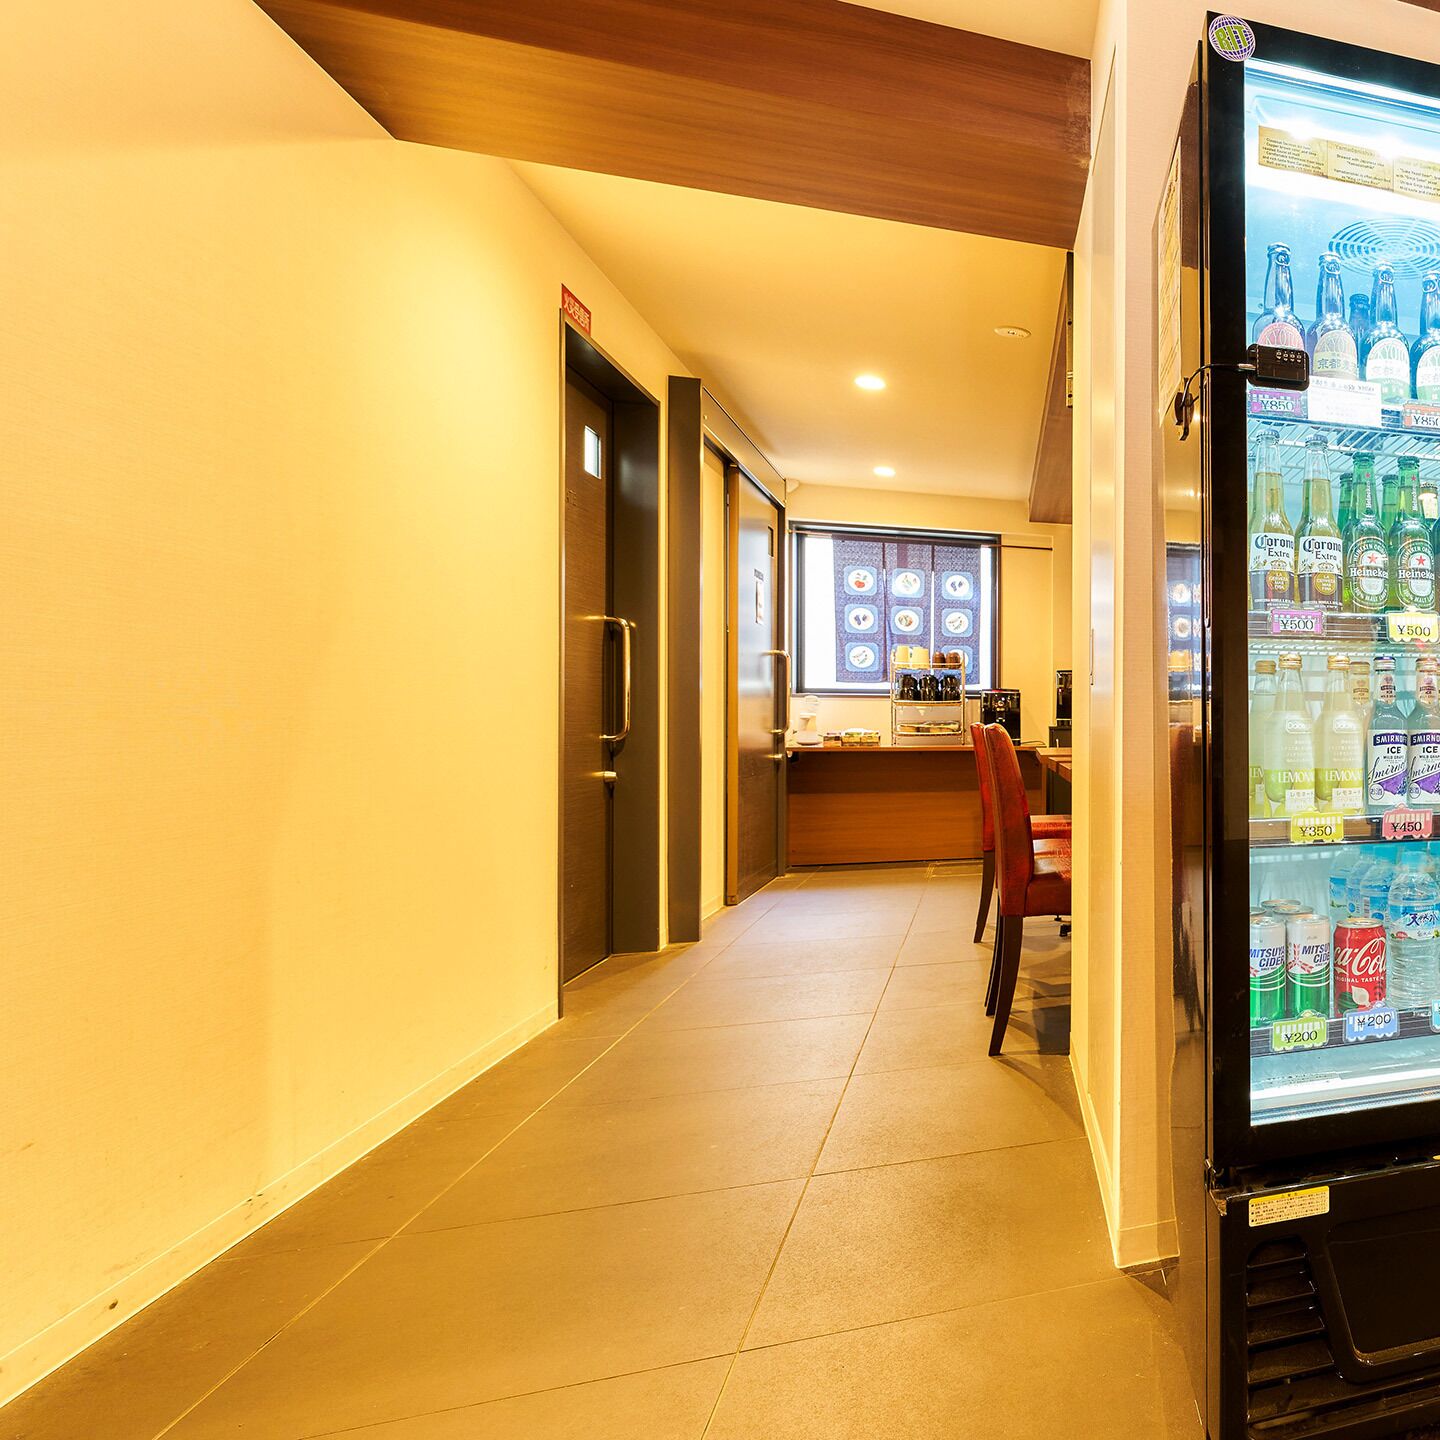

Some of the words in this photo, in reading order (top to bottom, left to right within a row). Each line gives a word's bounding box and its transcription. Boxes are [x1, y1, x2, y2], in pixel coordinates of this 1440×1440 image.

[1268, 548, 1290, 558] Extra
[1315, 551, 1337, 560] Extra
[1386, 746, 1401, 754] ICE
[1299, 825, 1333, 837] ¥350
[1391, 822, 1422, 833] ¥450
[1357, 1014, 1392, 1027] ¥200
[1285, 1030, 1318, 1043] ¥200
